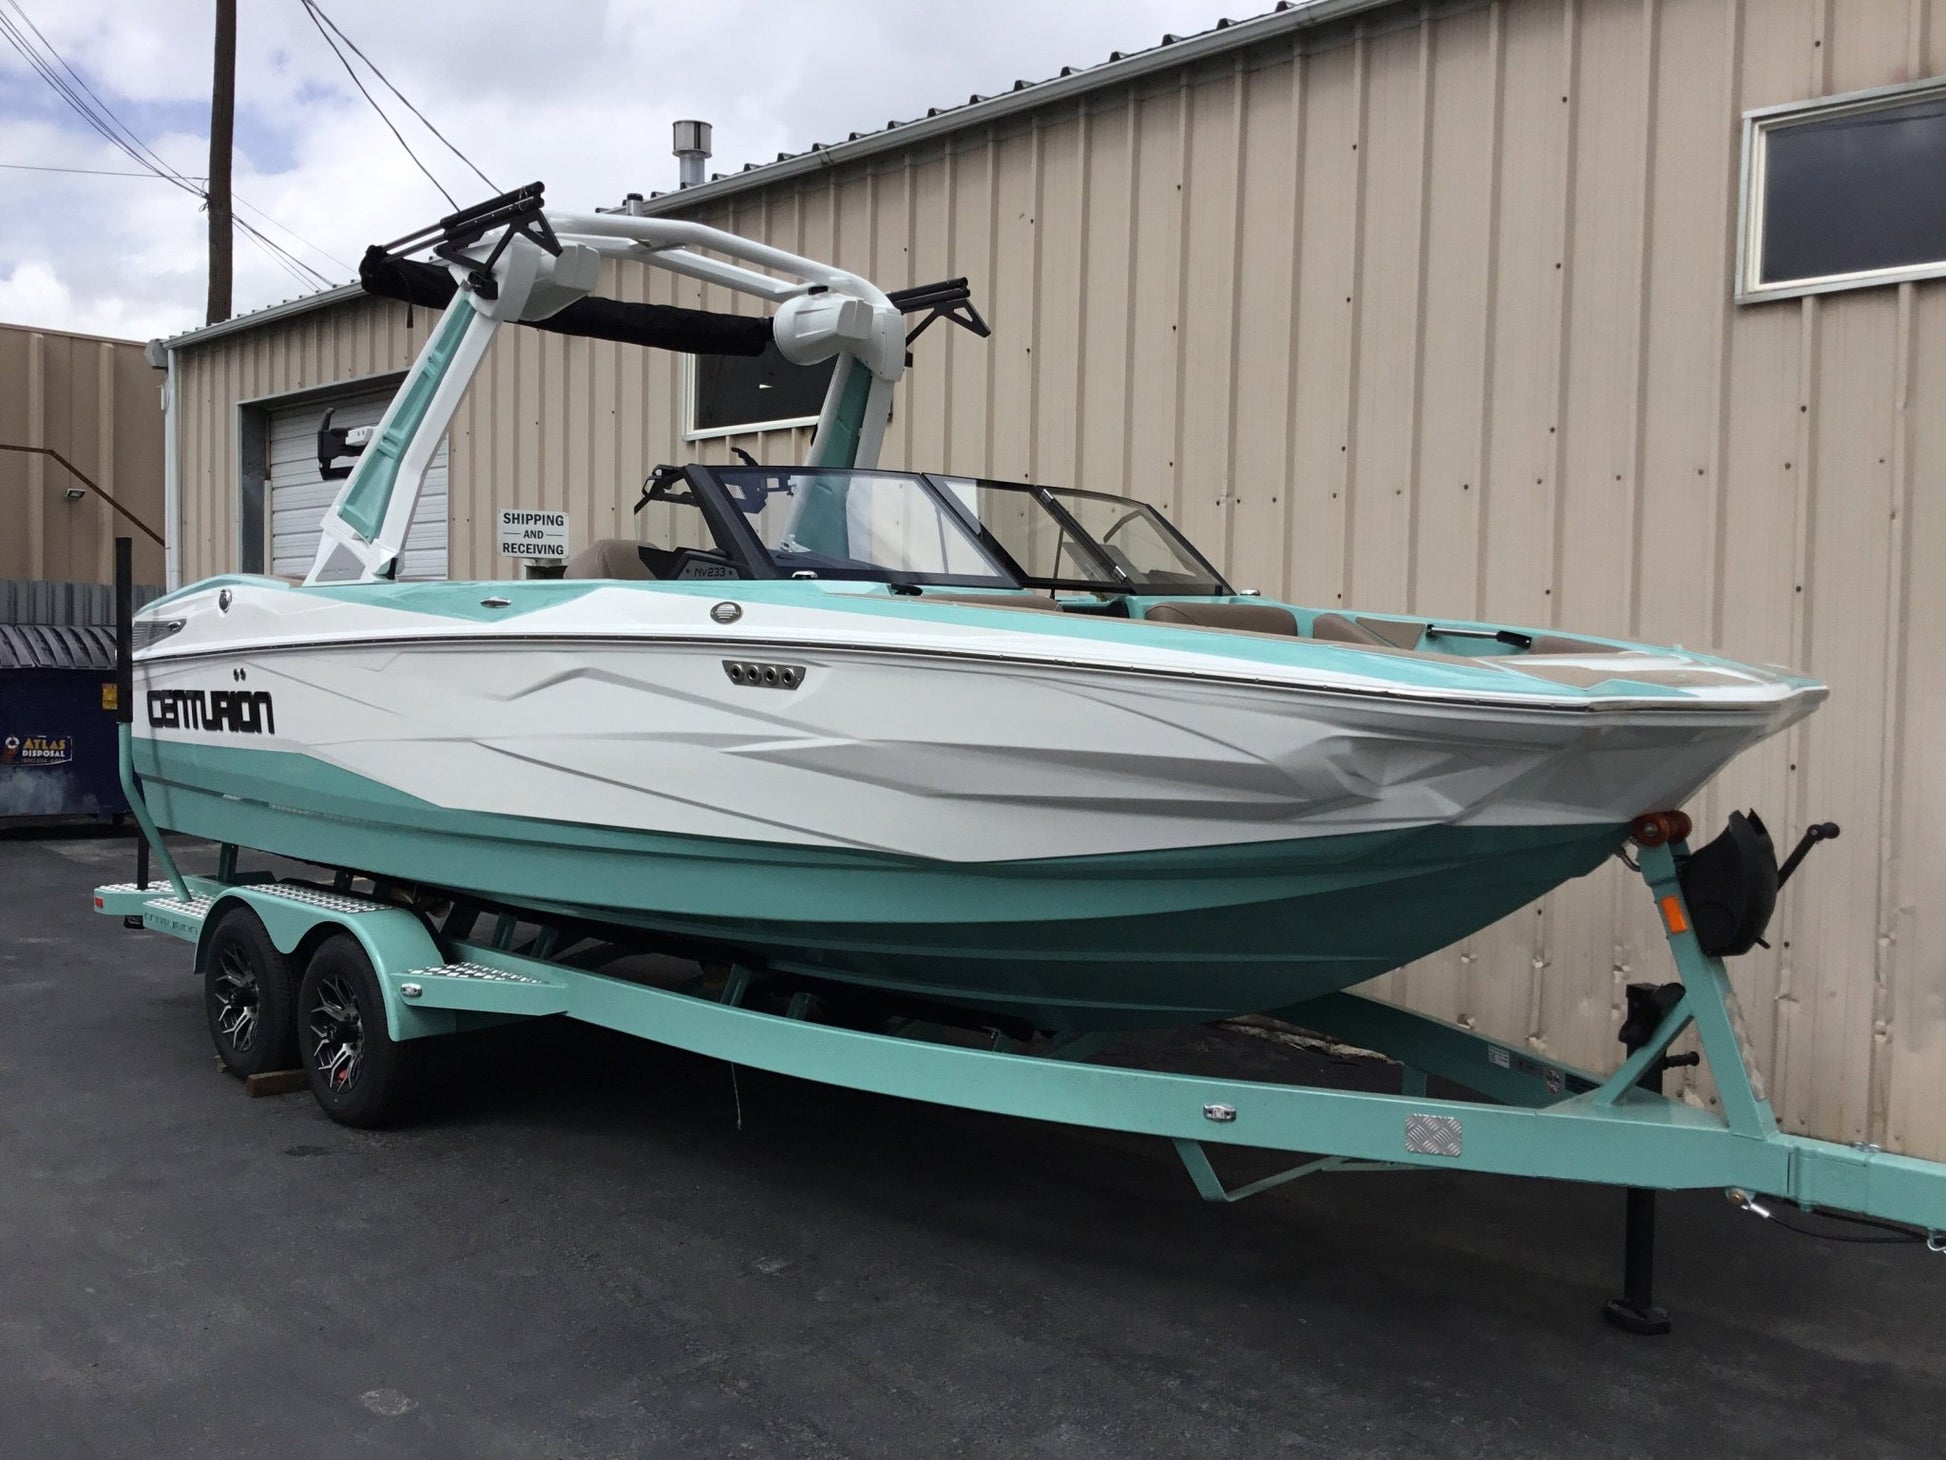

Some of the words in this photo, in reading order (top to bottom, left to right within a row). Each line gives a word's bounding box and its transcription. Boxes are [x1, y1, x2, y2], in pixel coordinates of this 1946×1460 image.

[503, 512, 564, 526] SHIPPING
[523, 530, 544, 539] AND
[502, 542, 564, 555] RECEIVING
[147, 689, 275, 734] CENTURION
[23, 737, 66, 749] ATLAS
[22, 749, 65, 757] DISPOSAL
